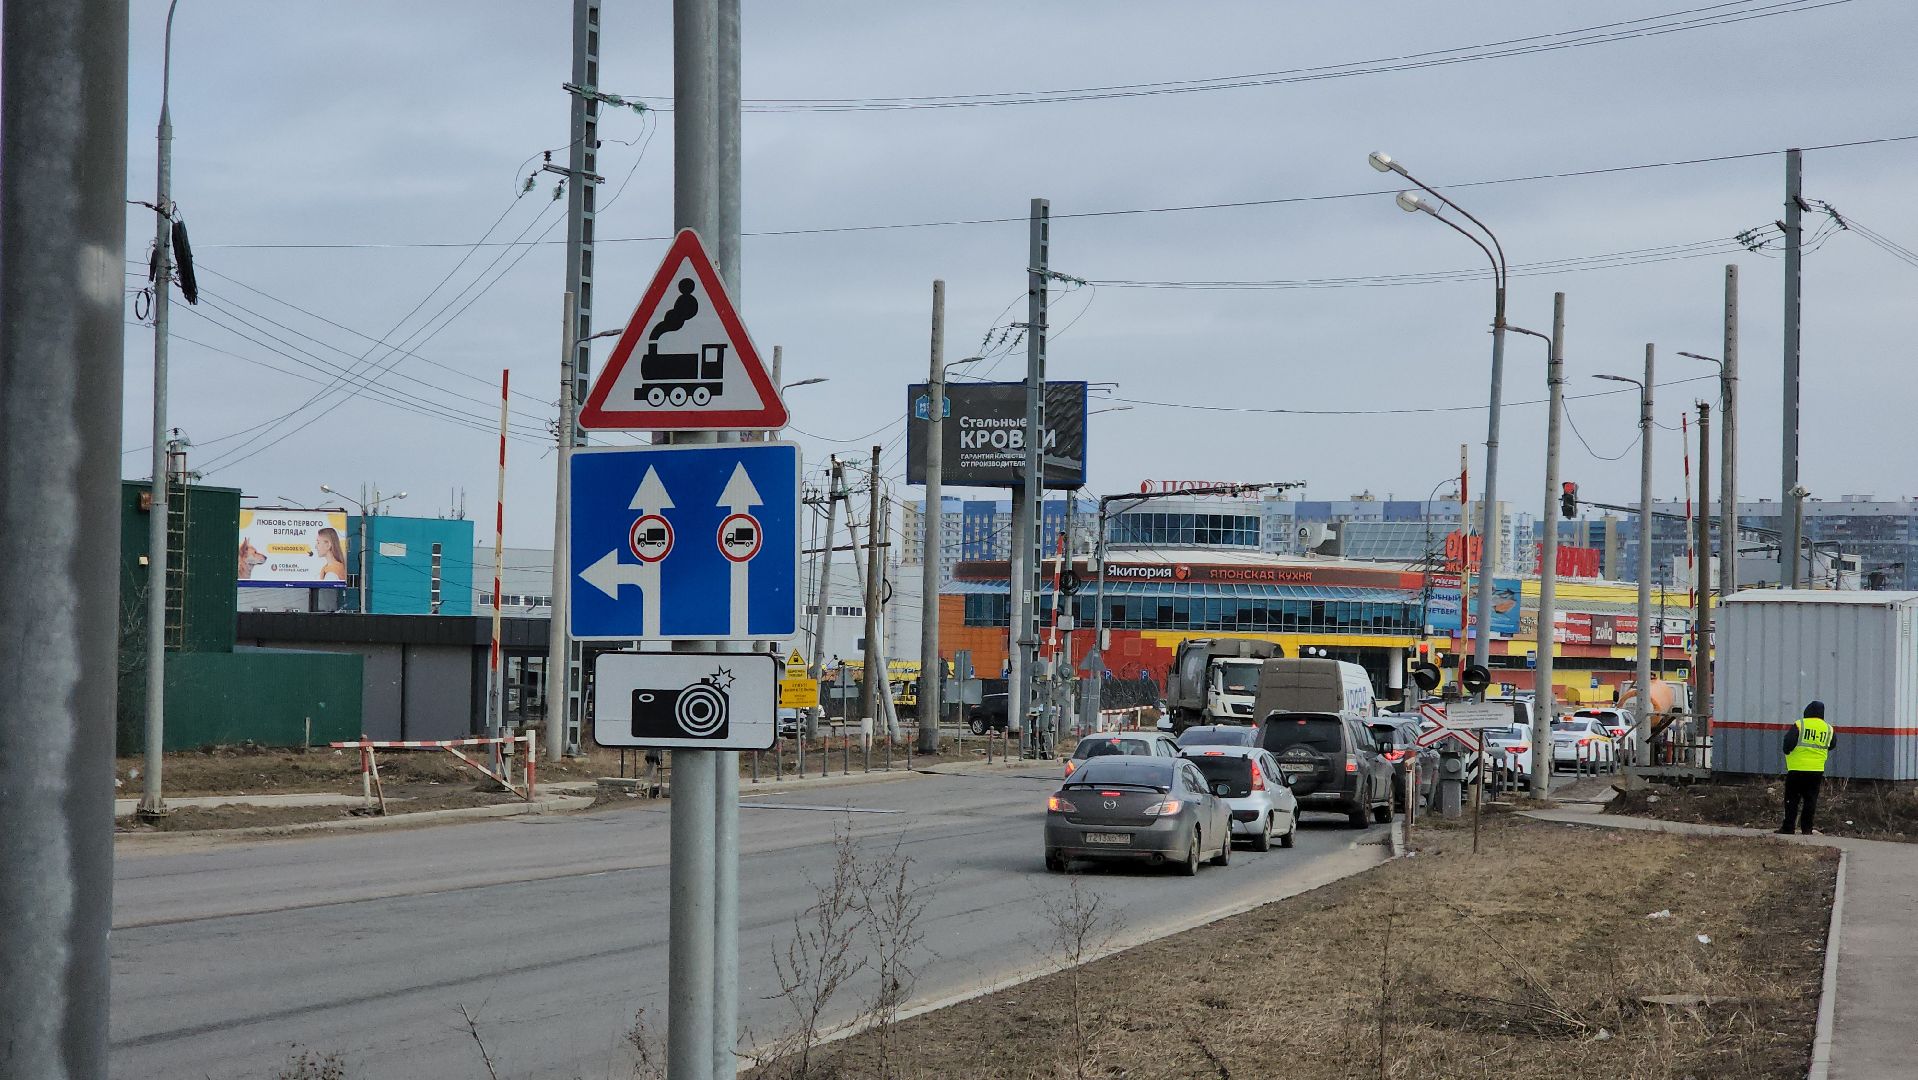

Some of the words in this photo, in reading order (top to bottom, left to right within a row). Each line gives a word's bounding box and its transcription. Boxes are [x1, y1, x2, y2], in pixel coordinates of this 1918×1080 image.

[959, 416, 1027, 428] Стальные
[960, 429, 1057, 449] КРОВИ
[293, 519, 324, 527] ПЕРВОГО
[1108, 564, 1172, 579] Якитория
[1210, 569, 1274, 580] ЯПОНСКАЯ
[1278, 571, 1312, 581] КУХНЯ
